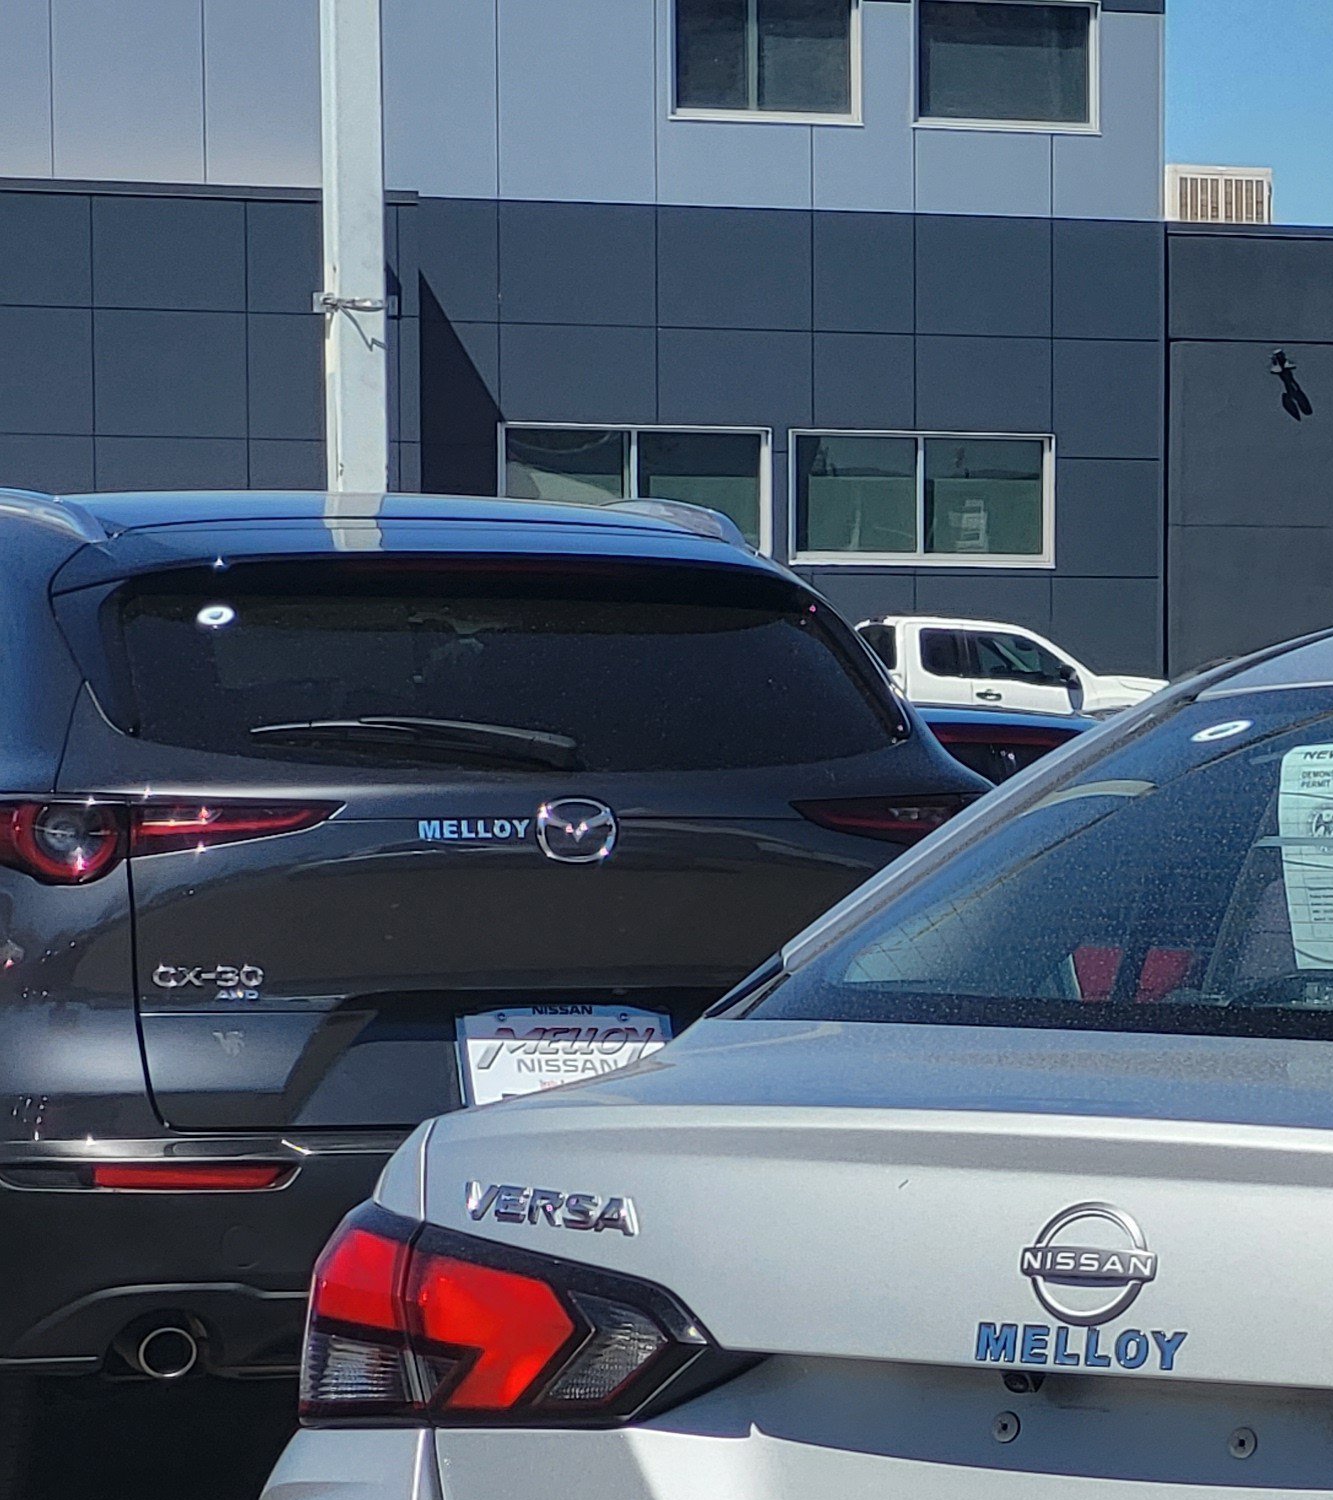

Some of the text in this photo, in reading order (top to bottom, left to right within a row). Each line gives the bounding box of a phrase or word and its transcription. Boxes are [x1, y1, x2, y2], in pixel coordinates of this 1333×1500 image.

[1301, 780, 1331, 788] PERMIT
[418, 819, 530, 839] MELLOY
[152, 964, 264, 988] CX-30
[532, 1005, 593, 1016] NISSAN
[478, 1027, 656, 1069] MELLOY
[517, 1058, 618, 1074] NISSAN
[465, 1179, 640, 1237] VERSA
[1023, 1251, 1152, 1275] NISSAN
[976, 1322, 1188, 1370] MELLOY
